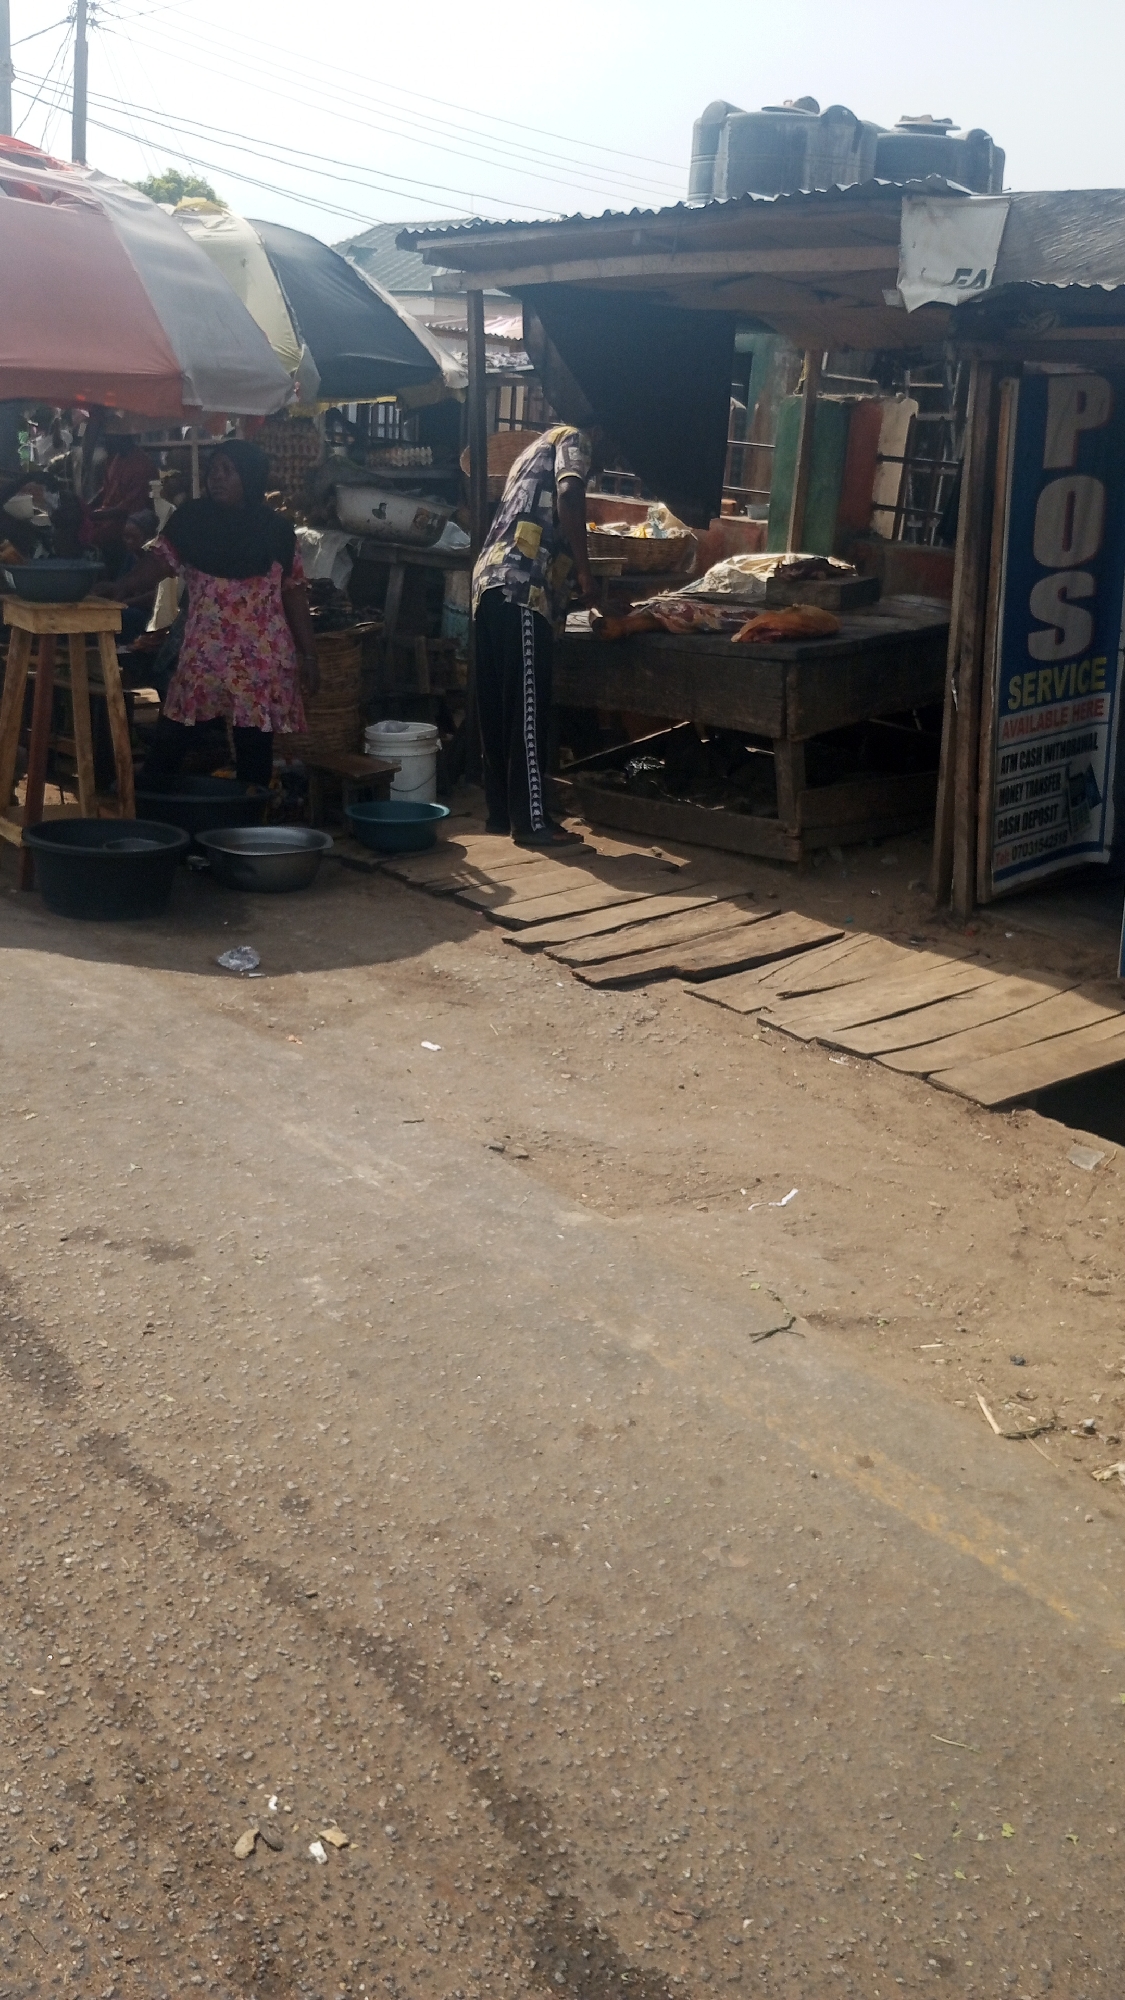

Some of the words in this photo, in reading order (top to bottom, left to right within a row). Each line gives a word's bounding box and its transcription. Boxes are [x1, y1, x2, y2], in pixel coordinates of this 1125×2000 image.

[1027, 374, 1114, 662] POS
[1008, 658, 1106, 710] SERVICE
[1002, 706, 1069, 740] AVAILABLE
[1072, 697, 1105, 722] HERE
[1000, 752, 1019, 775] ATM
[1019, 746, 1043, 770] CASH
[997, 814, 1021, 840] CASH
[1022, 803, 1059, 831] DEPOSIT
